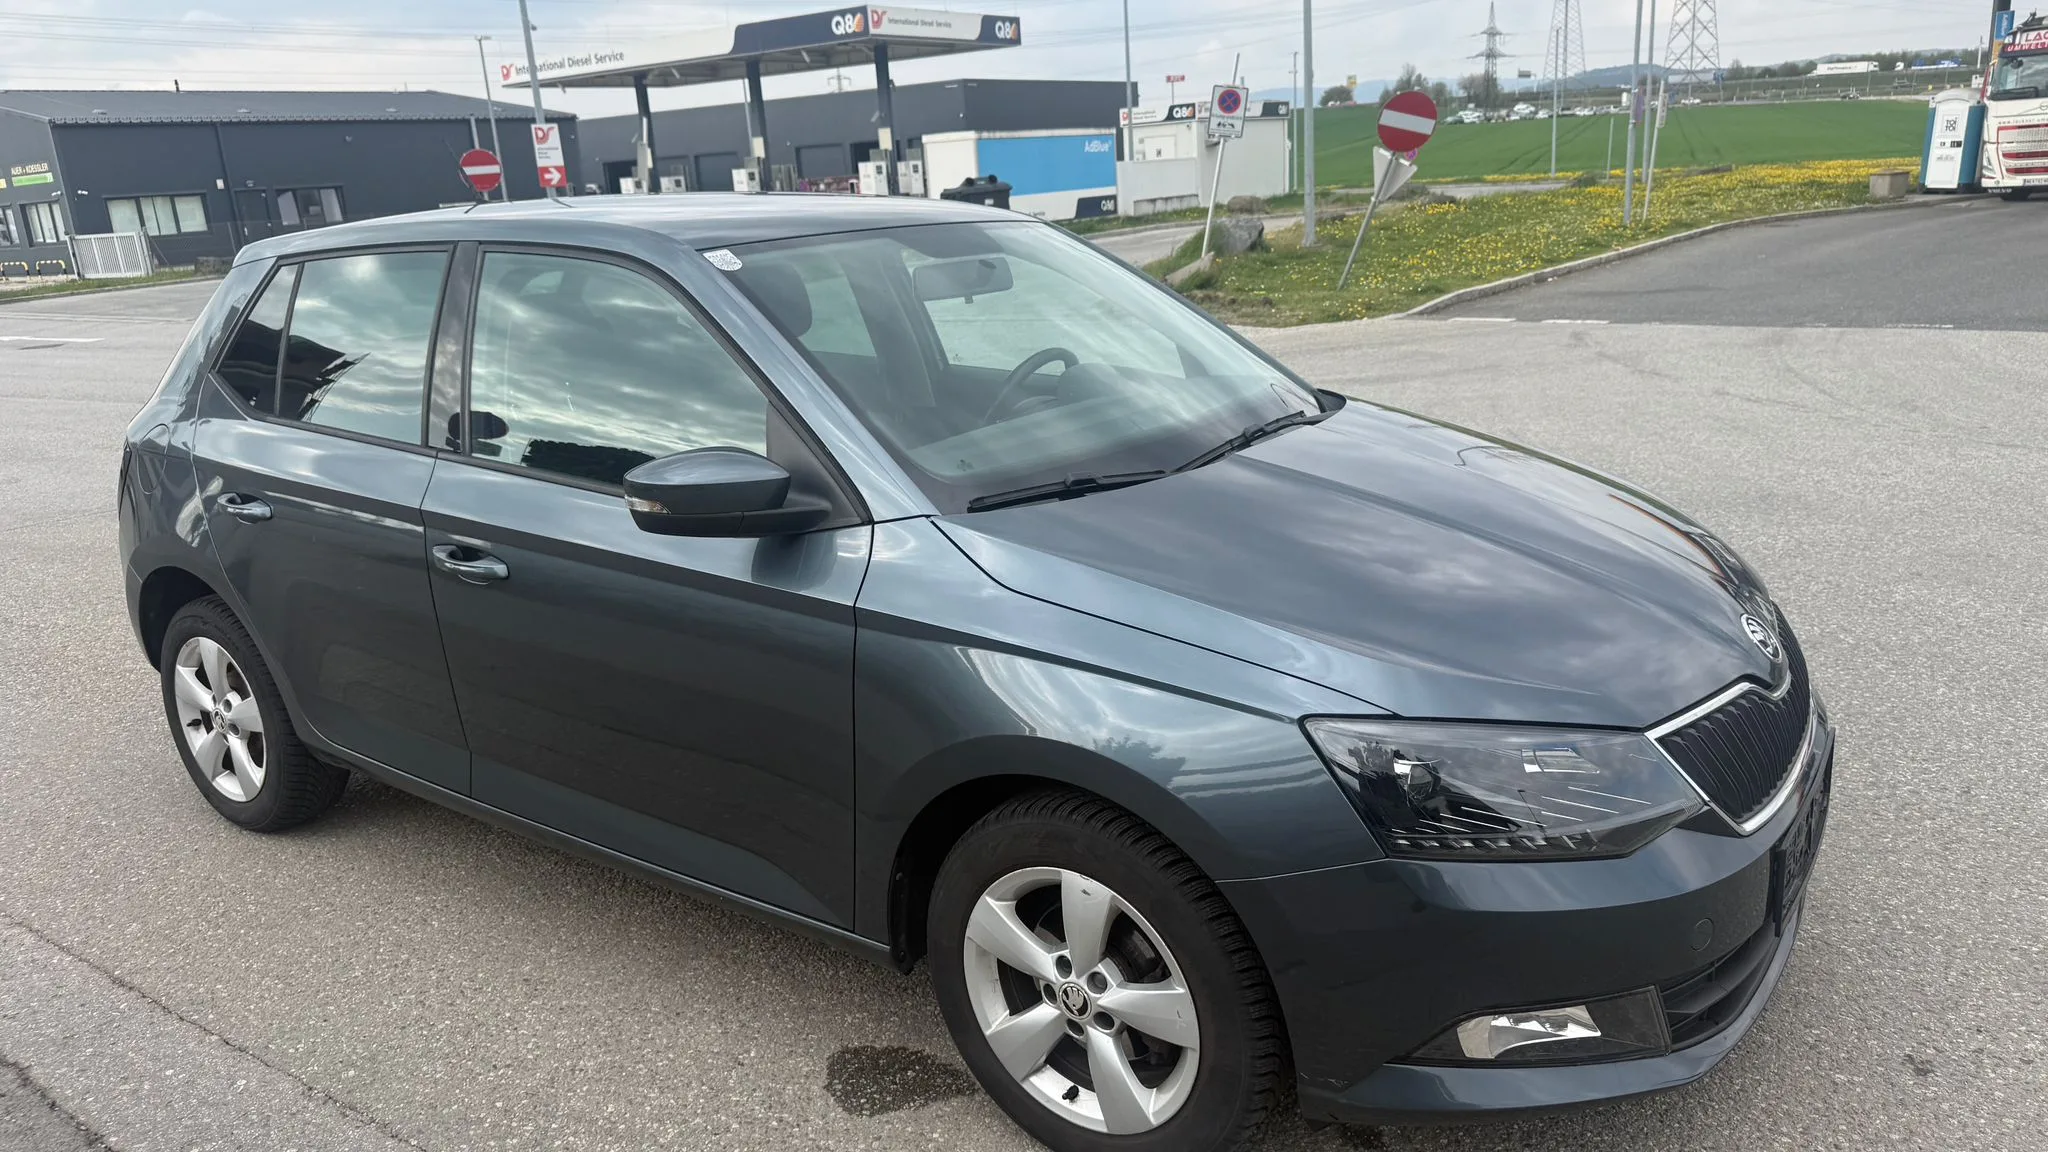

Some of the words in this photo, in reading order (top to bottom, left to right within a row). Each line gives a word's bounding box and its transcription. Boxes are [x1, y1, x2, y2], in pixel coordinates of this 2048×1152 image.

[831, 13, 855, 35] Q8
[995, 21, 1012, 39] Q8
[568, 54, 591, 68] Diesel
[595, 51, 624, 64] Service
[1173, 107, 1187, 118] Q8
